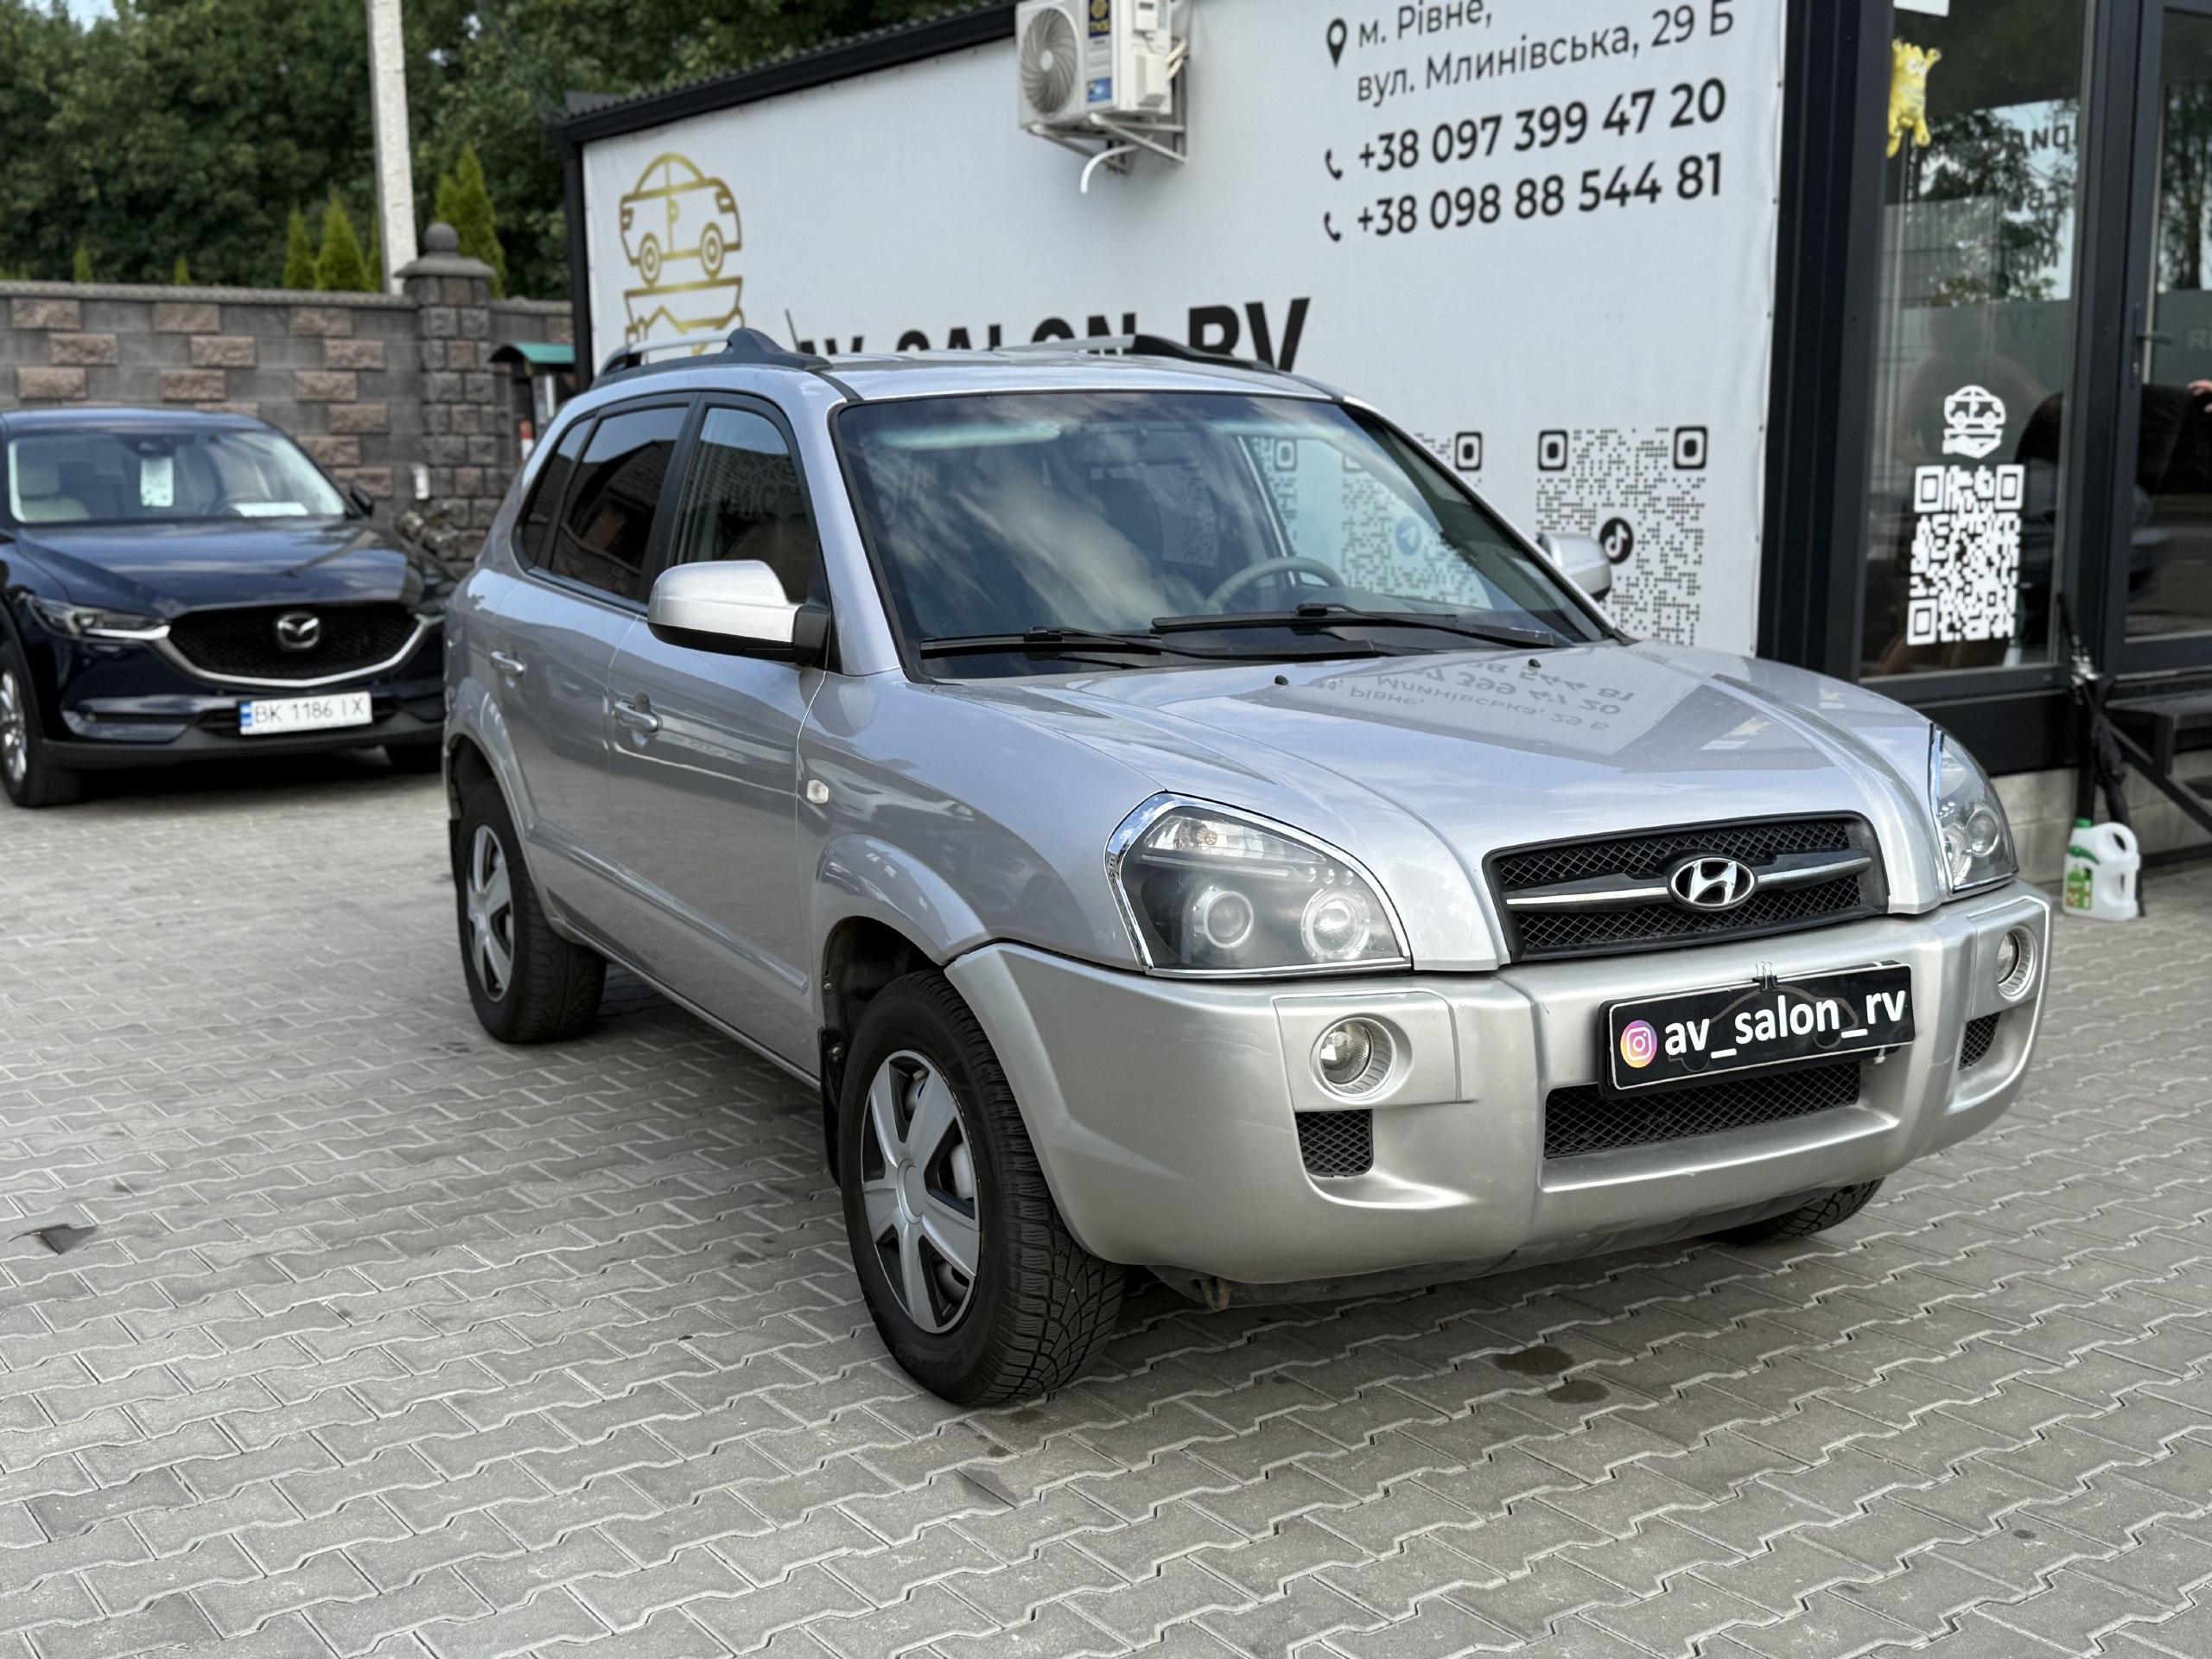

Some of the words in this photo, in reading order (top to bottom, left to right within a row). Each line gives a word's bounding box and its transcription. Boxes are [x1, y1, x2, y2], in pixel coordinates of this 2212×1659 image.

[1357, 69, 1414, 107] вул.
[1427, 27, 1639, 89] Млинівська,
[1651, 5, 1695, 48] 29
[1710, 0, 1733, 36] Б
[1359, 21, 1386, 47] м.
[1398, 0, 1492, 38] Рівне,
[1358, 130, 1420, 173] +38
[1432, 115, 1503, 164] 097
[1514, 101, 1588, 152] 399
[1602, 89, 1656, 137] 47
[1669, 78, 1726, 129] 20
[1357, 195, 1418, 237] +38
[1430, 184, 1501, 230] 098
[1514, 175, 1565, 220] 88
[1578, 162, 1662, 213] 544
[1676, 152, 1721, 200] 81
[254, 705, 282, 724] BK
[290, 701, 334, 721] 1186
[1664, 989, 1906, 1060] av_salon_rv
